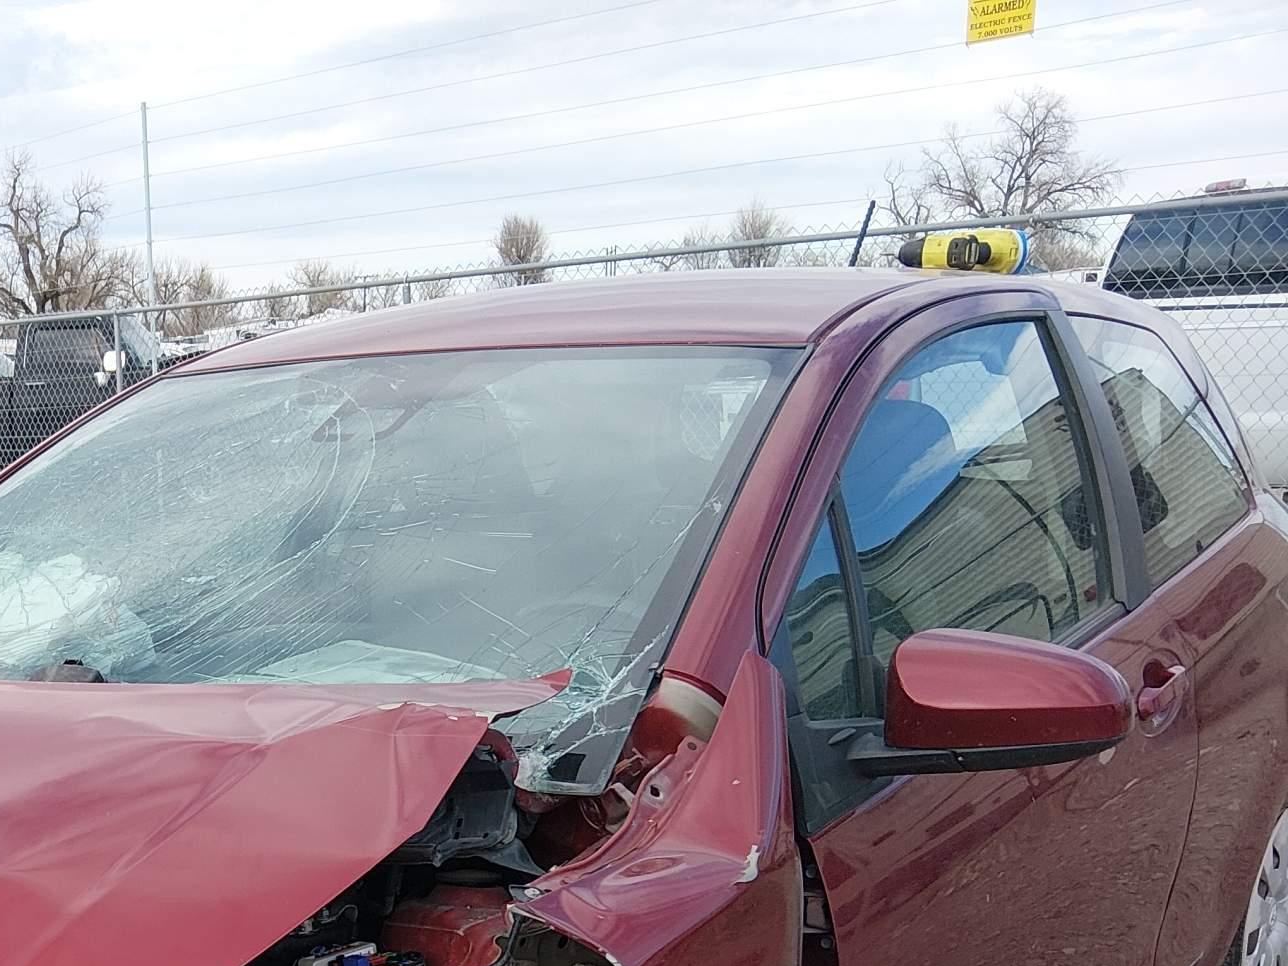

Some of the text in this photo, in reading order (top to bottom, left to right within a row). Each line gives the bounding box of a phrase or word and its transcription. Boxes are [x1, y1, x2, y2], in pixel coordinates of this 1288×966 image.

[979, 0, 1024, 16] ALARMED
[970, 13, 1032, 30] ELECTRIC FENCE
[1000, 25, 1023, 34] VOLTS
